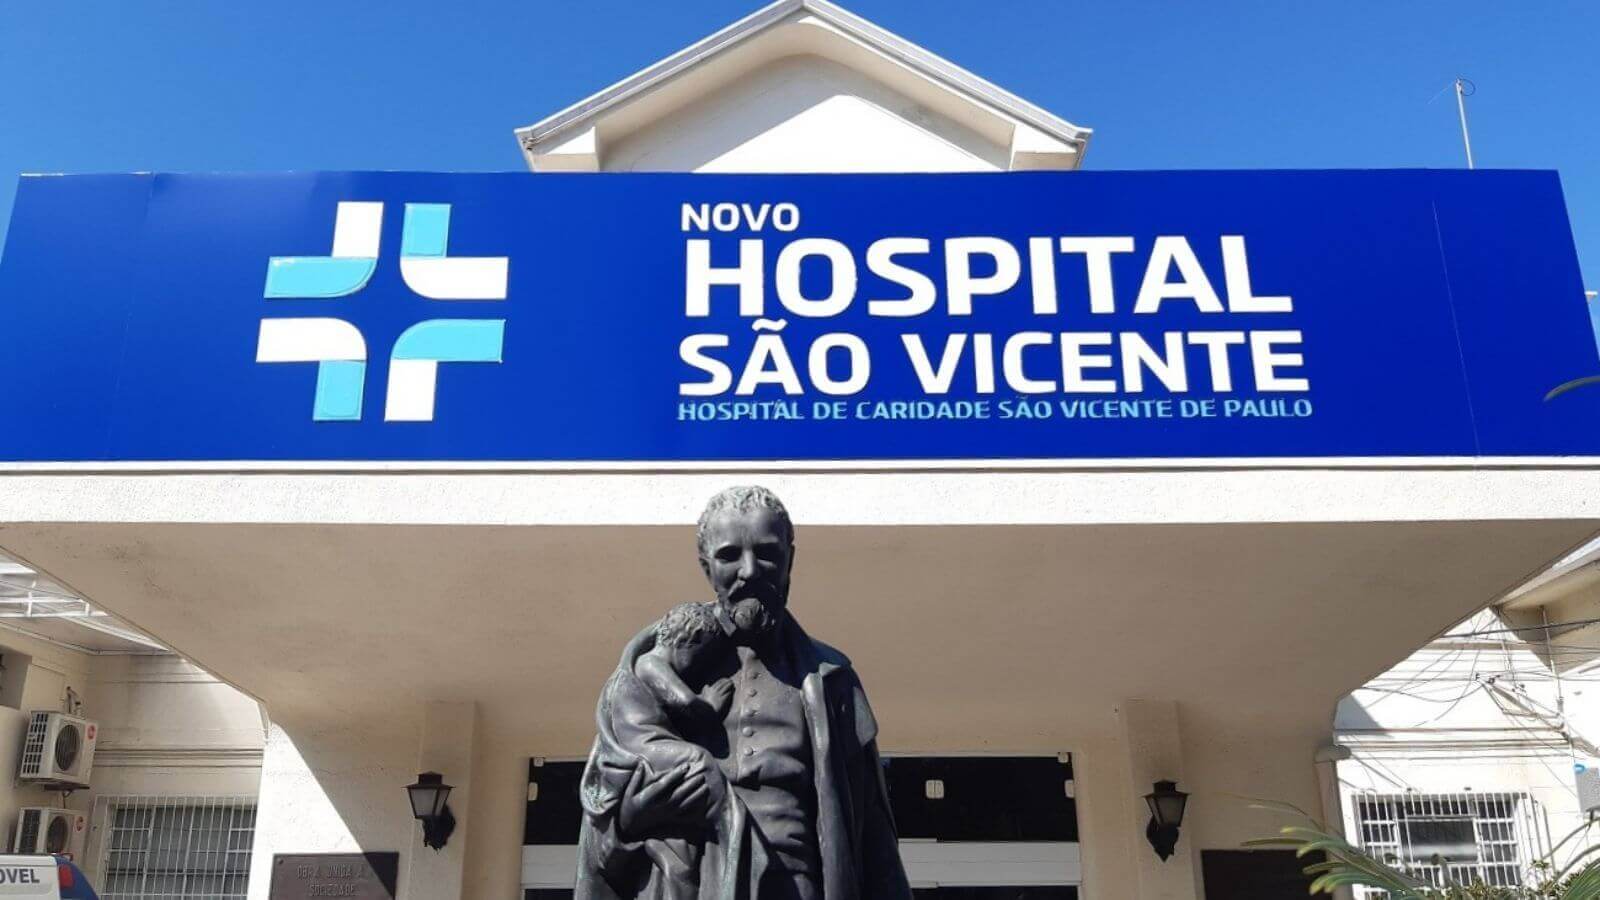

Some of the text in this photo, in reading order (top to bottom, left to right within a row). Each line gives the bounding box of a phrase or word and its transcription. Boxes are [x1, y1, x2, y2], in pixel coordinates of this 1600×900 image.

[680, 202, 800, 232] NOVO
[685, 235, 1294, 318] HOSPITAL
[678, 318, 1310, 397] SÃO VICENTE
[677, 397, 1313, 421] HOSPITAL DE CARIDADE SÃO VICENTE DE PAULO
